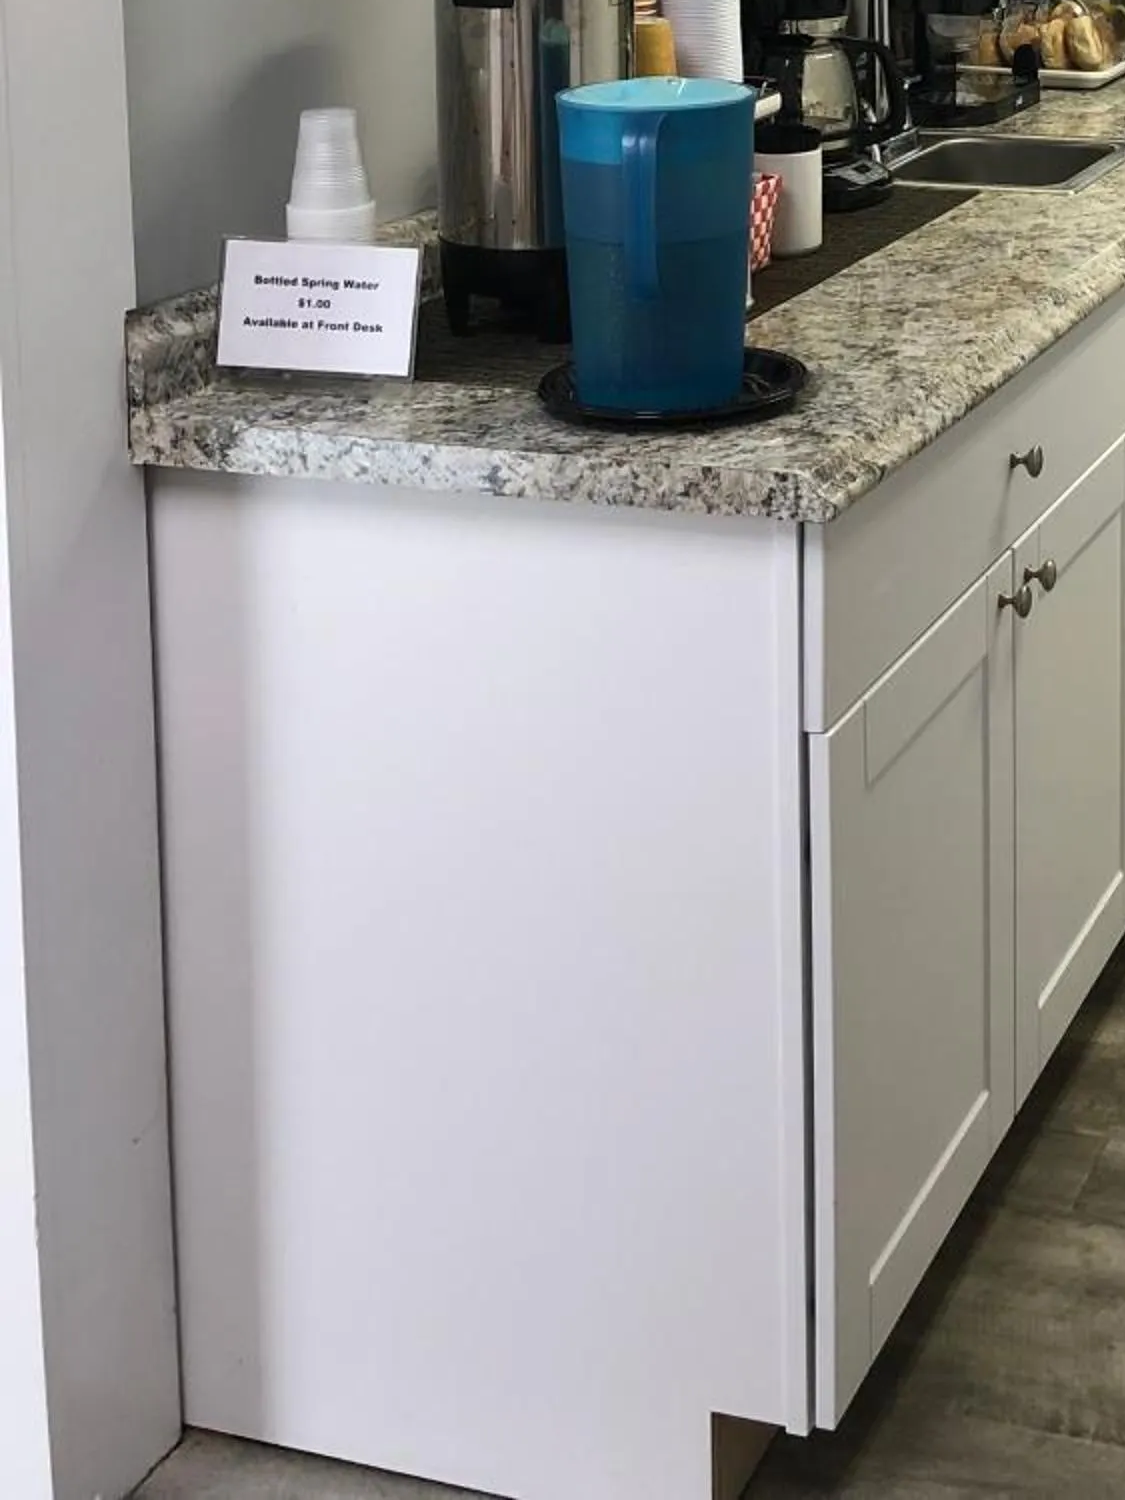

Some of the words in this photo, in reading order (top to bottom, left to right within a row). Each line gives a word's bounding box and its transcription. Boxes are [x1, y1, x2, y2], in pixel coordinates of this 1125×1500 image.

[254, 275, 299, 287] Bottled
[301, 277, 340, 291] Spring
[343, 279, 380, 291] Water
[298, 298, 331, 309] $1.00
[243, 316, 299, 330] Available
[301, 320, 314, 330] at
[317, 320, 350, 332] Front
[353, 322, 384, 334] Desk
